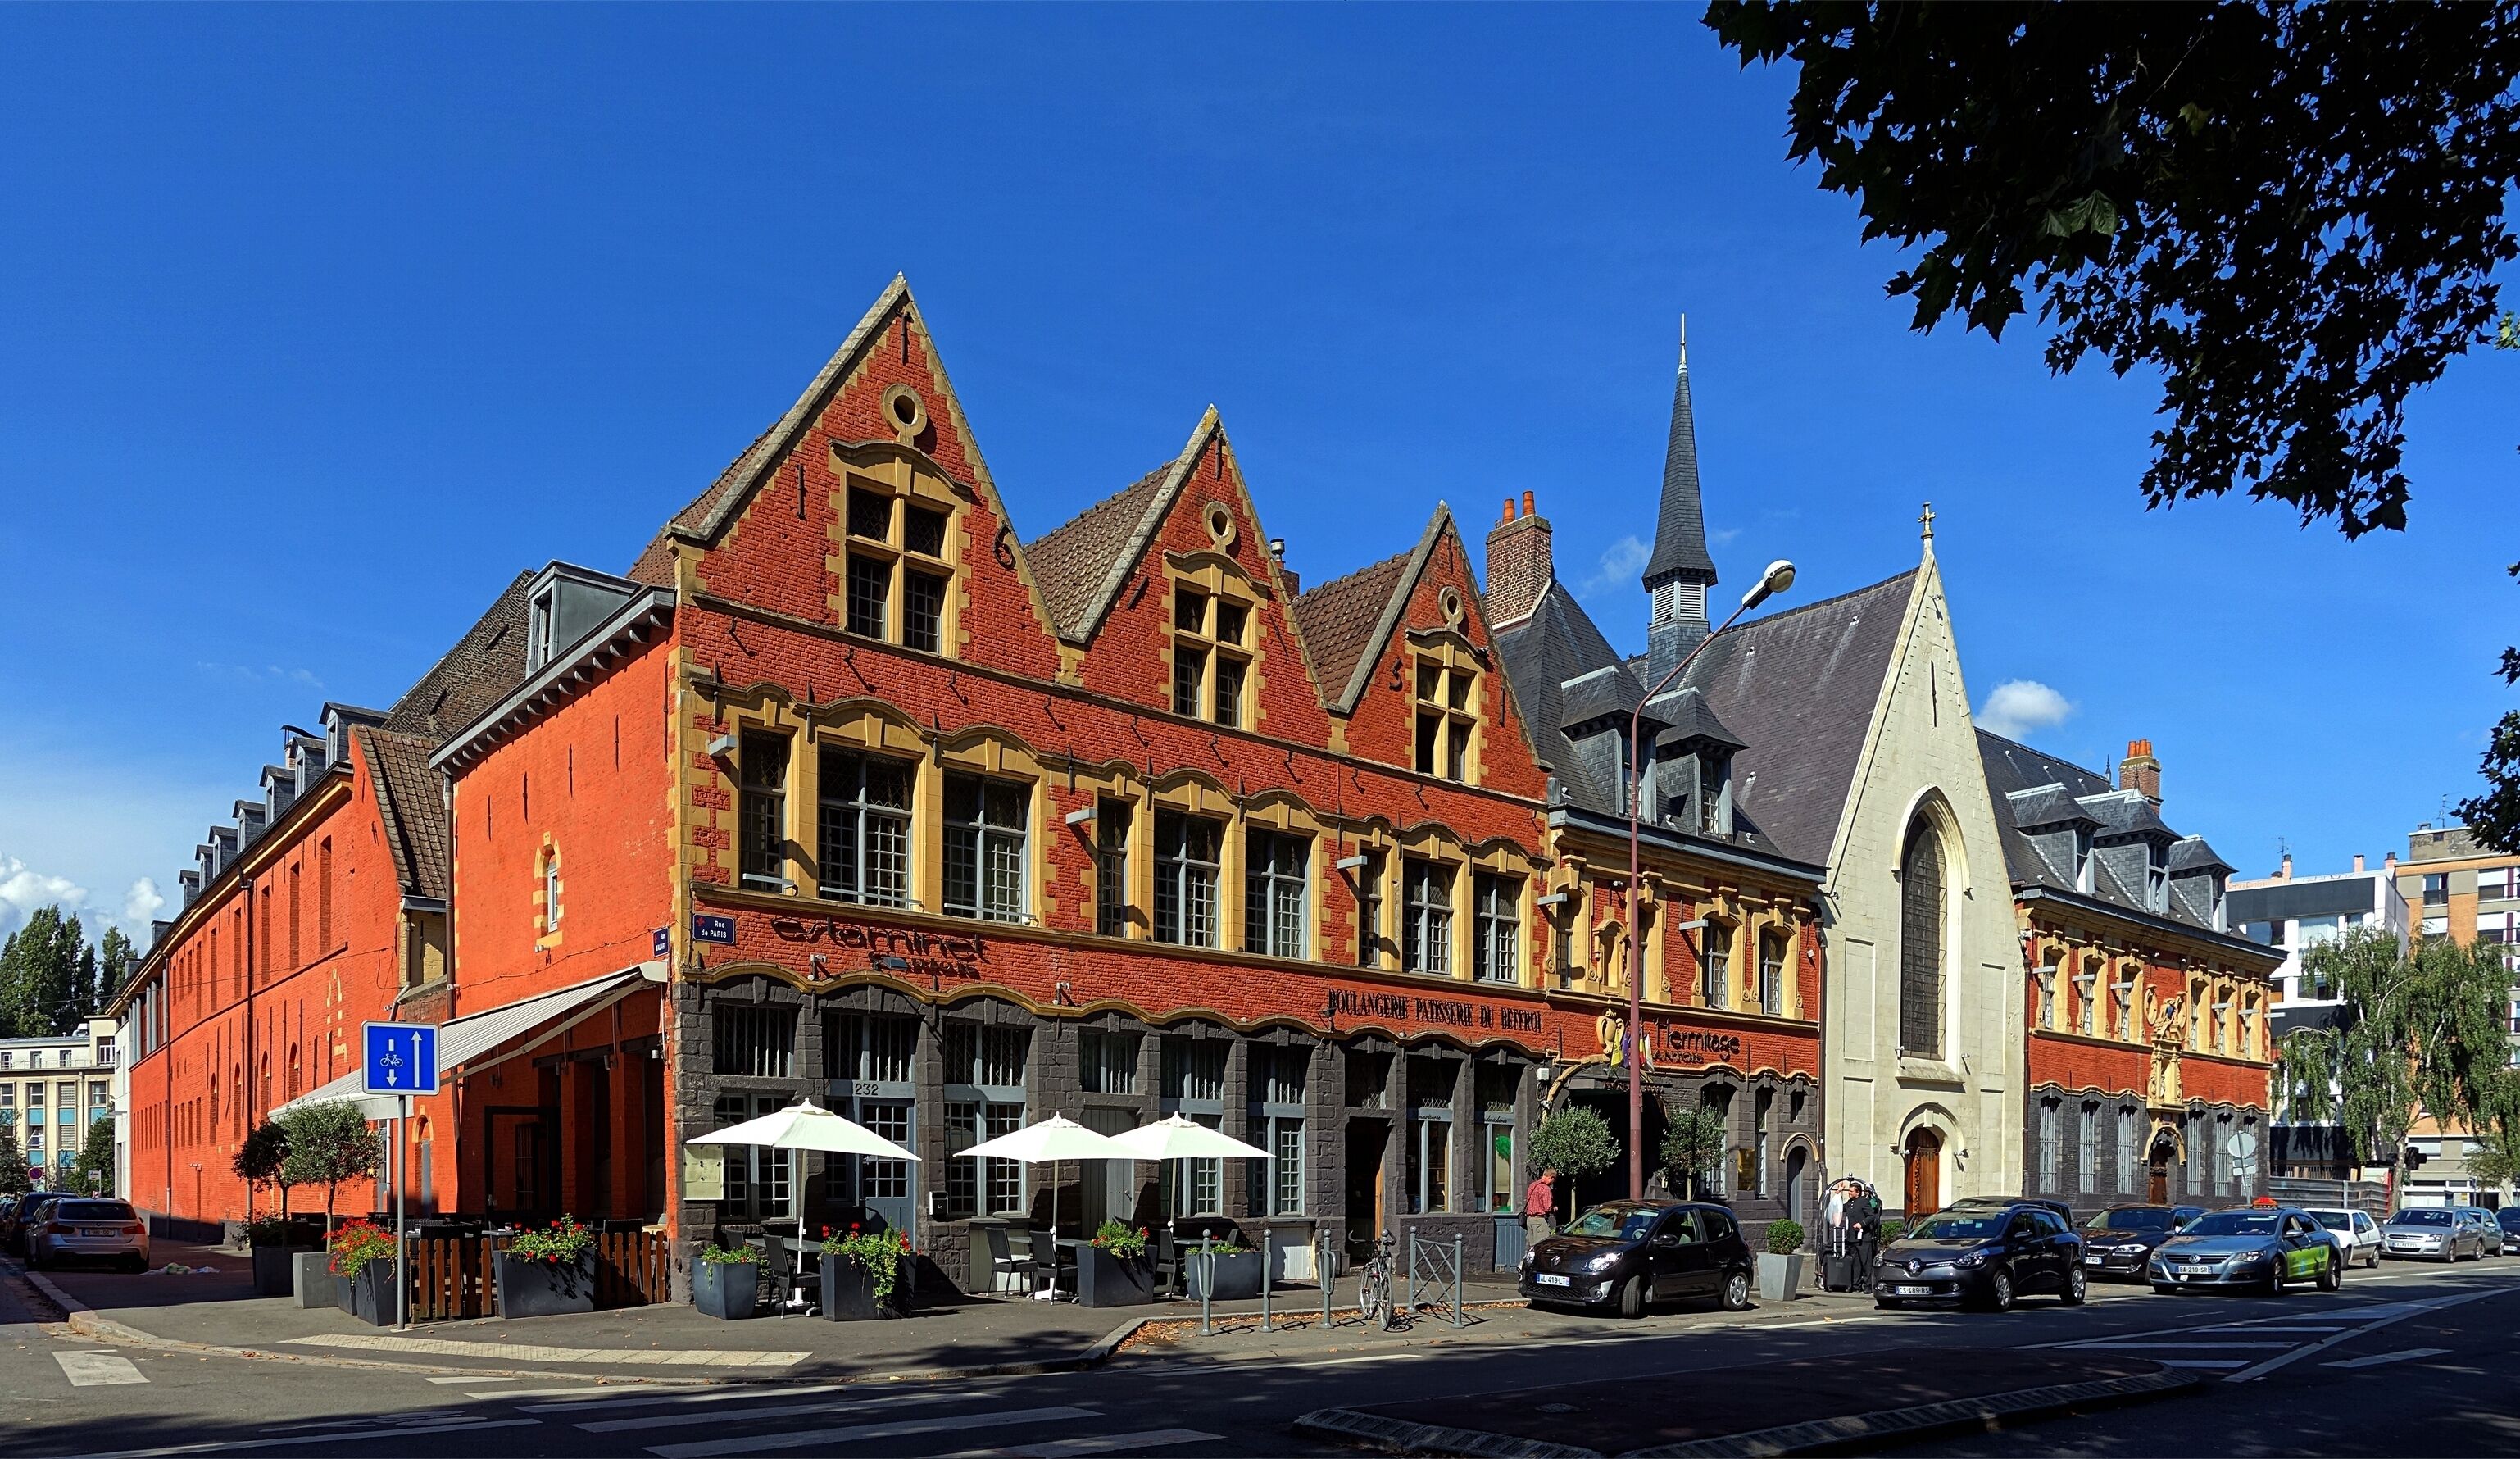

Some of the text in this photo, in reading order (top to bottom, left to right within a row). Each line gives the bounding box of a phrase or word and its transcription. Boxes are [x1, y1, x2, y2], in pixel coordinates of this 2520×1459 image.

[710, 929, 727, 939] PARIS
[1328, 989, 1542, 1033] BOULANGERIE PATISSERIE DU BEFFROI
[1652, 1049, 1704, 1064] ANTOIS
[855, 1083, 879, 1096] 232
[1541, 1275, 1565, 1284] AL-419-LT
